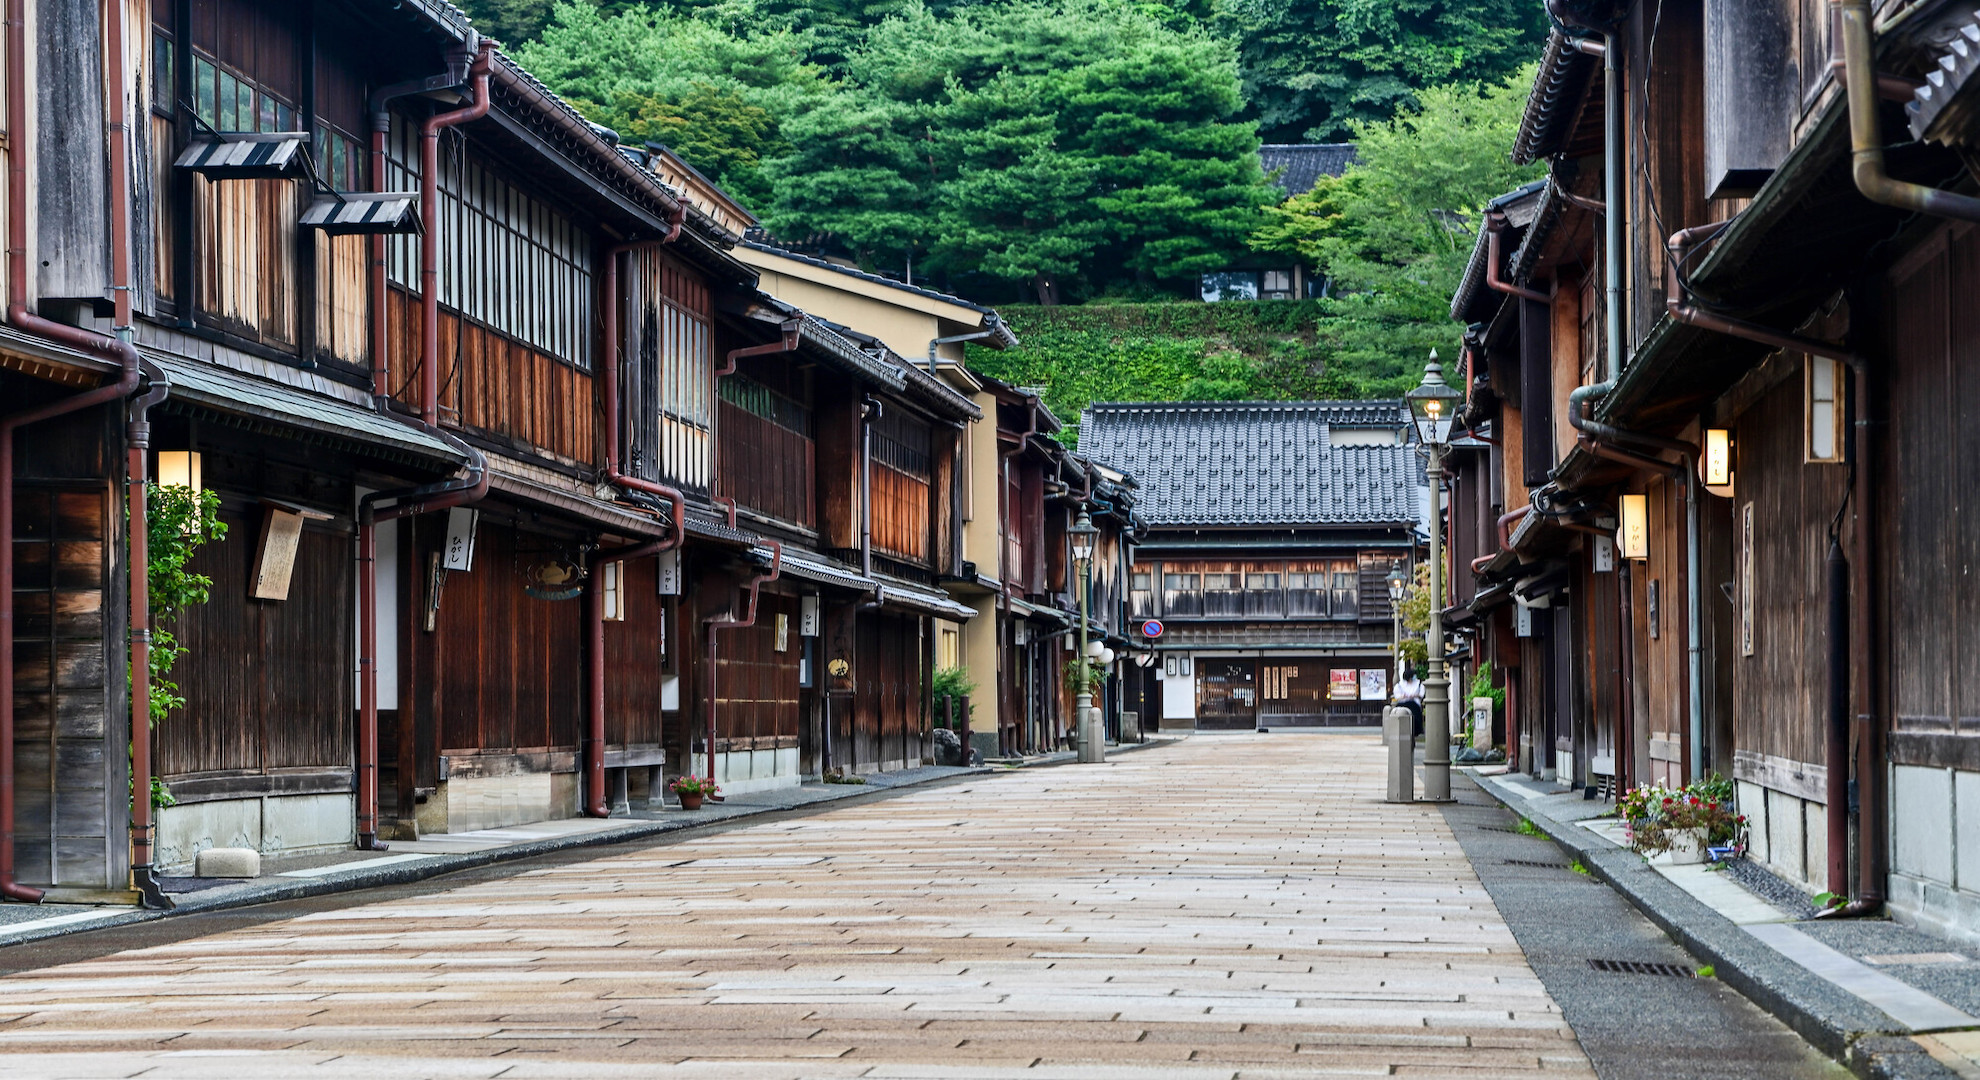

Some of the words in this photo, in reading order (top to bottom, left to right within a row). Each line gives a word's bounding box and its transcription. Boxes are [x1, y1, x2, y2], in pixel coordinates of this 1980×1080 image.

[451, 536, 462, 563] ひがし
[1632, 524, 1640, 551] ひがし
[664, 569, 672, 591] ひがし
